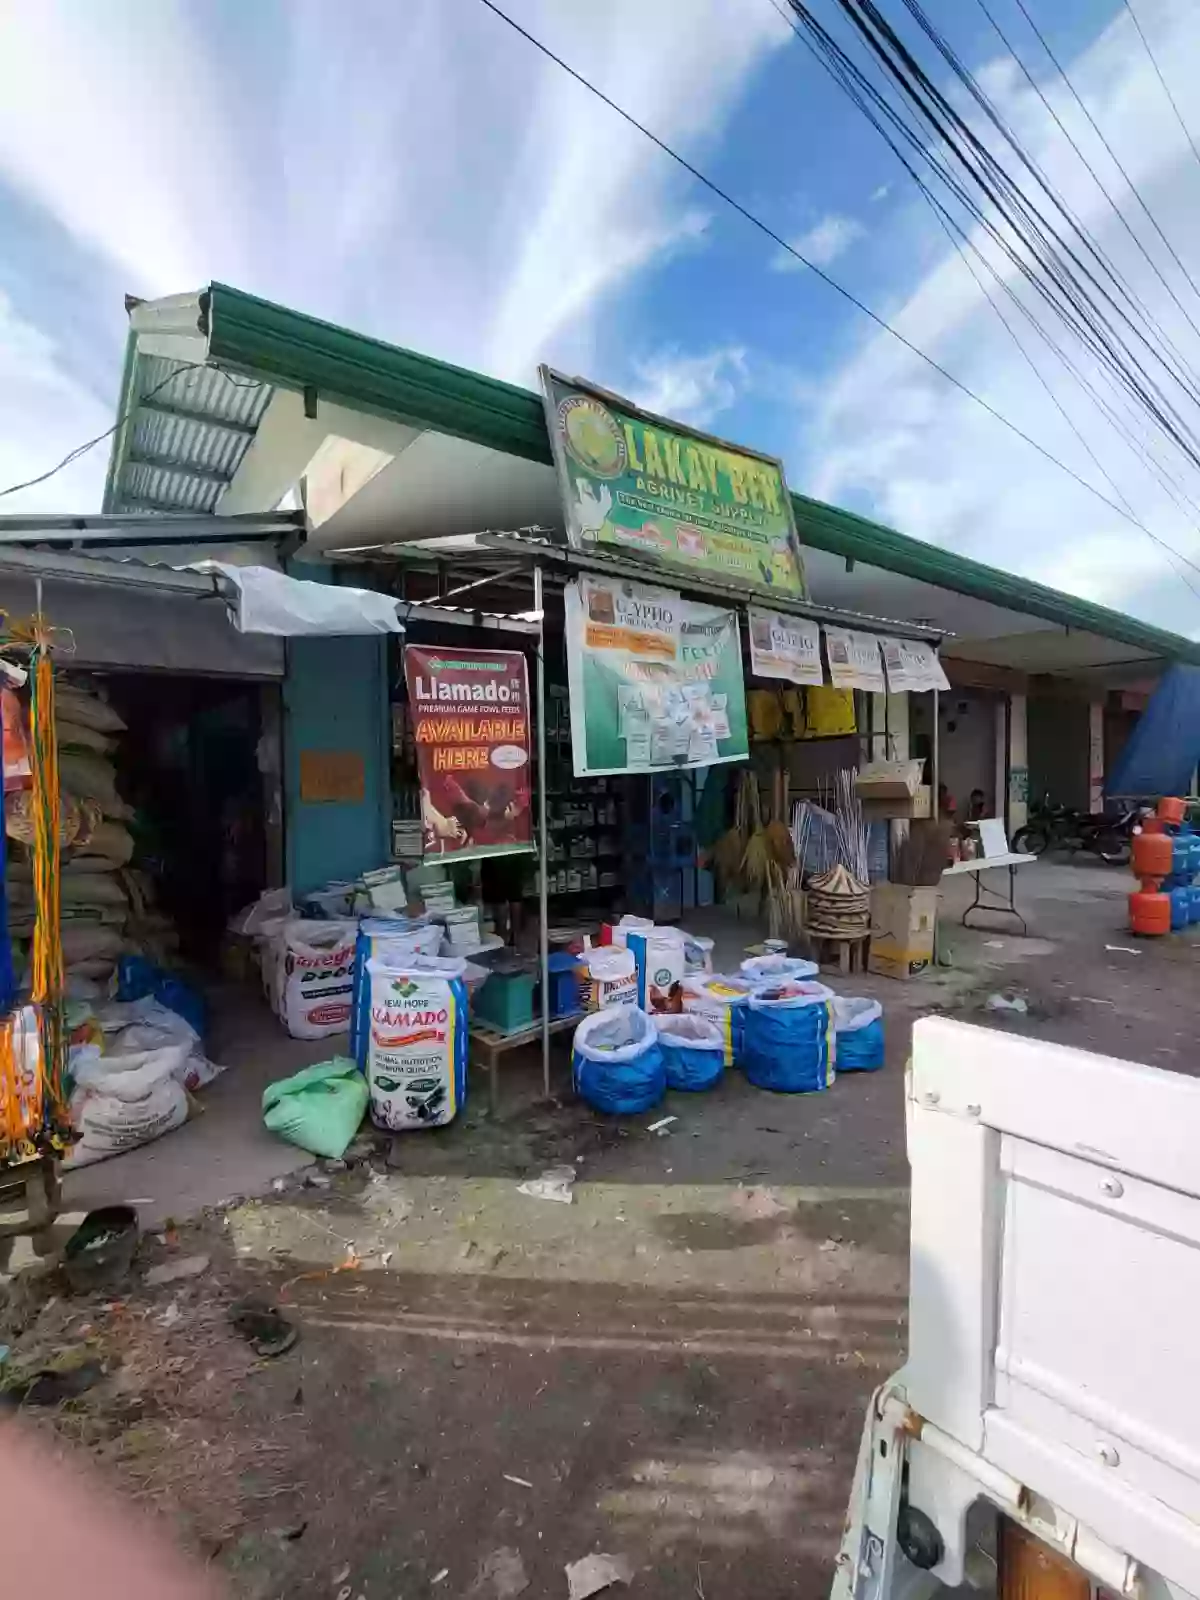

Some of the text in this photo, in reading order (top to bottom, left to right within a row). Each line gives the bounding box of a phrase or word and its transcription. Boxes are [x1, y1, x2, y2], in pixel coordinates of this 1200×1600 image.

[624, 423, 719, 496] LAKAY
[636, 478, 704, 509] AGRIVET
[416, 676, 510, 702] Llamado
[419, 704, 520, 713] PREMIUM GAME FOWL FEEDS
[416, 719, 525, 743] AVAILABLE
[434, 746, 489, 771] HERE
[404, 999, 429, 1009] HOPE
